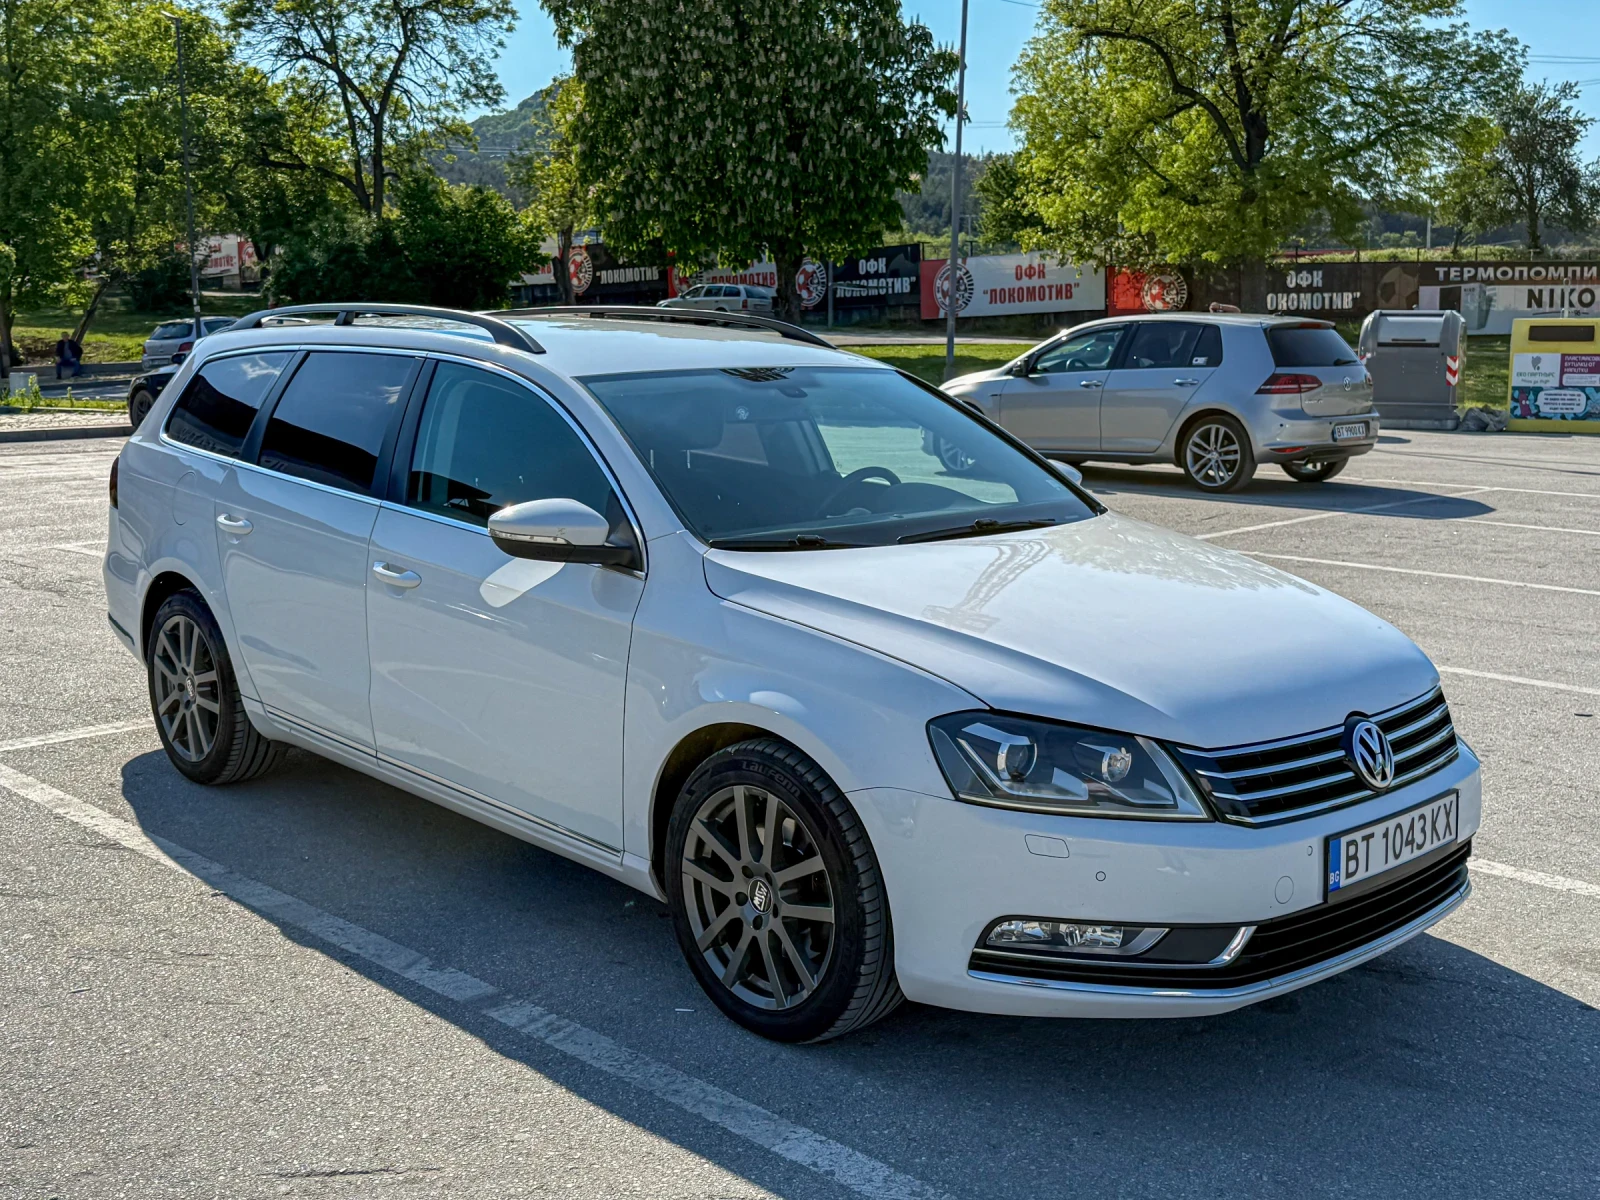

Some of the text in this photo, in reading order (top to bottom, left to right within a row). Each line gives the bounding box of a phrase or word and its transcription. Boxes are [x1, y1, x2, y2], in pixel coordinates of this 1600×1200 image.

[858, 257, 887, 275] ОФК
[1015, 264, 1046, 281] ОФК
[1435, 266, 1597, 281] ТЕРМОПОМПИ
[1526, 287, 1596, 309] NIKO
[1345, 832, 1375, 880] BT
[1382, 813, 1427, 866] 1043
[1329, 870, 1340, 885] BG
